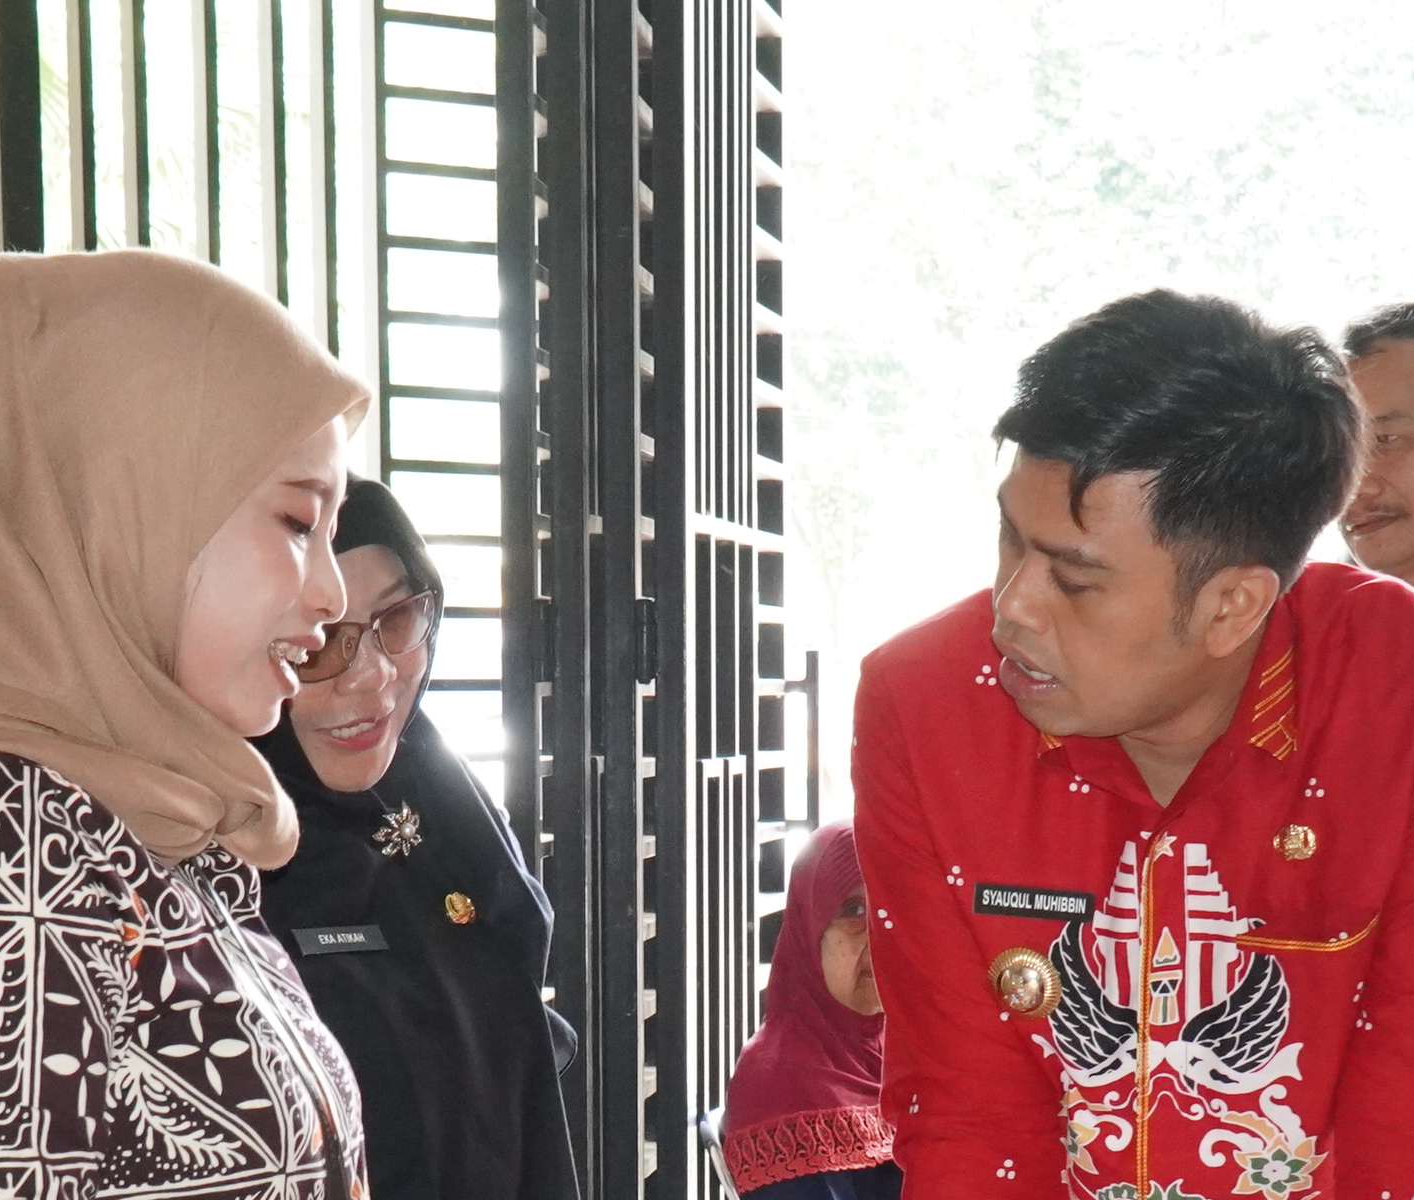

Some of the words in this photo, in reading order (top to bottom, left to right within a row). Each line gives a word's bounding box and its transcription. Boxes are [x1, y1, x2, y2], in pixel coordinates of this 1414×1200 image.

[982, 889, 1032, 909] SYAUQUL
[1033, 894, 1087, 914] MUHIBBIN
[317, 933, 337, 945] EKA
[337, 932, 366, 944] ATIKAH
